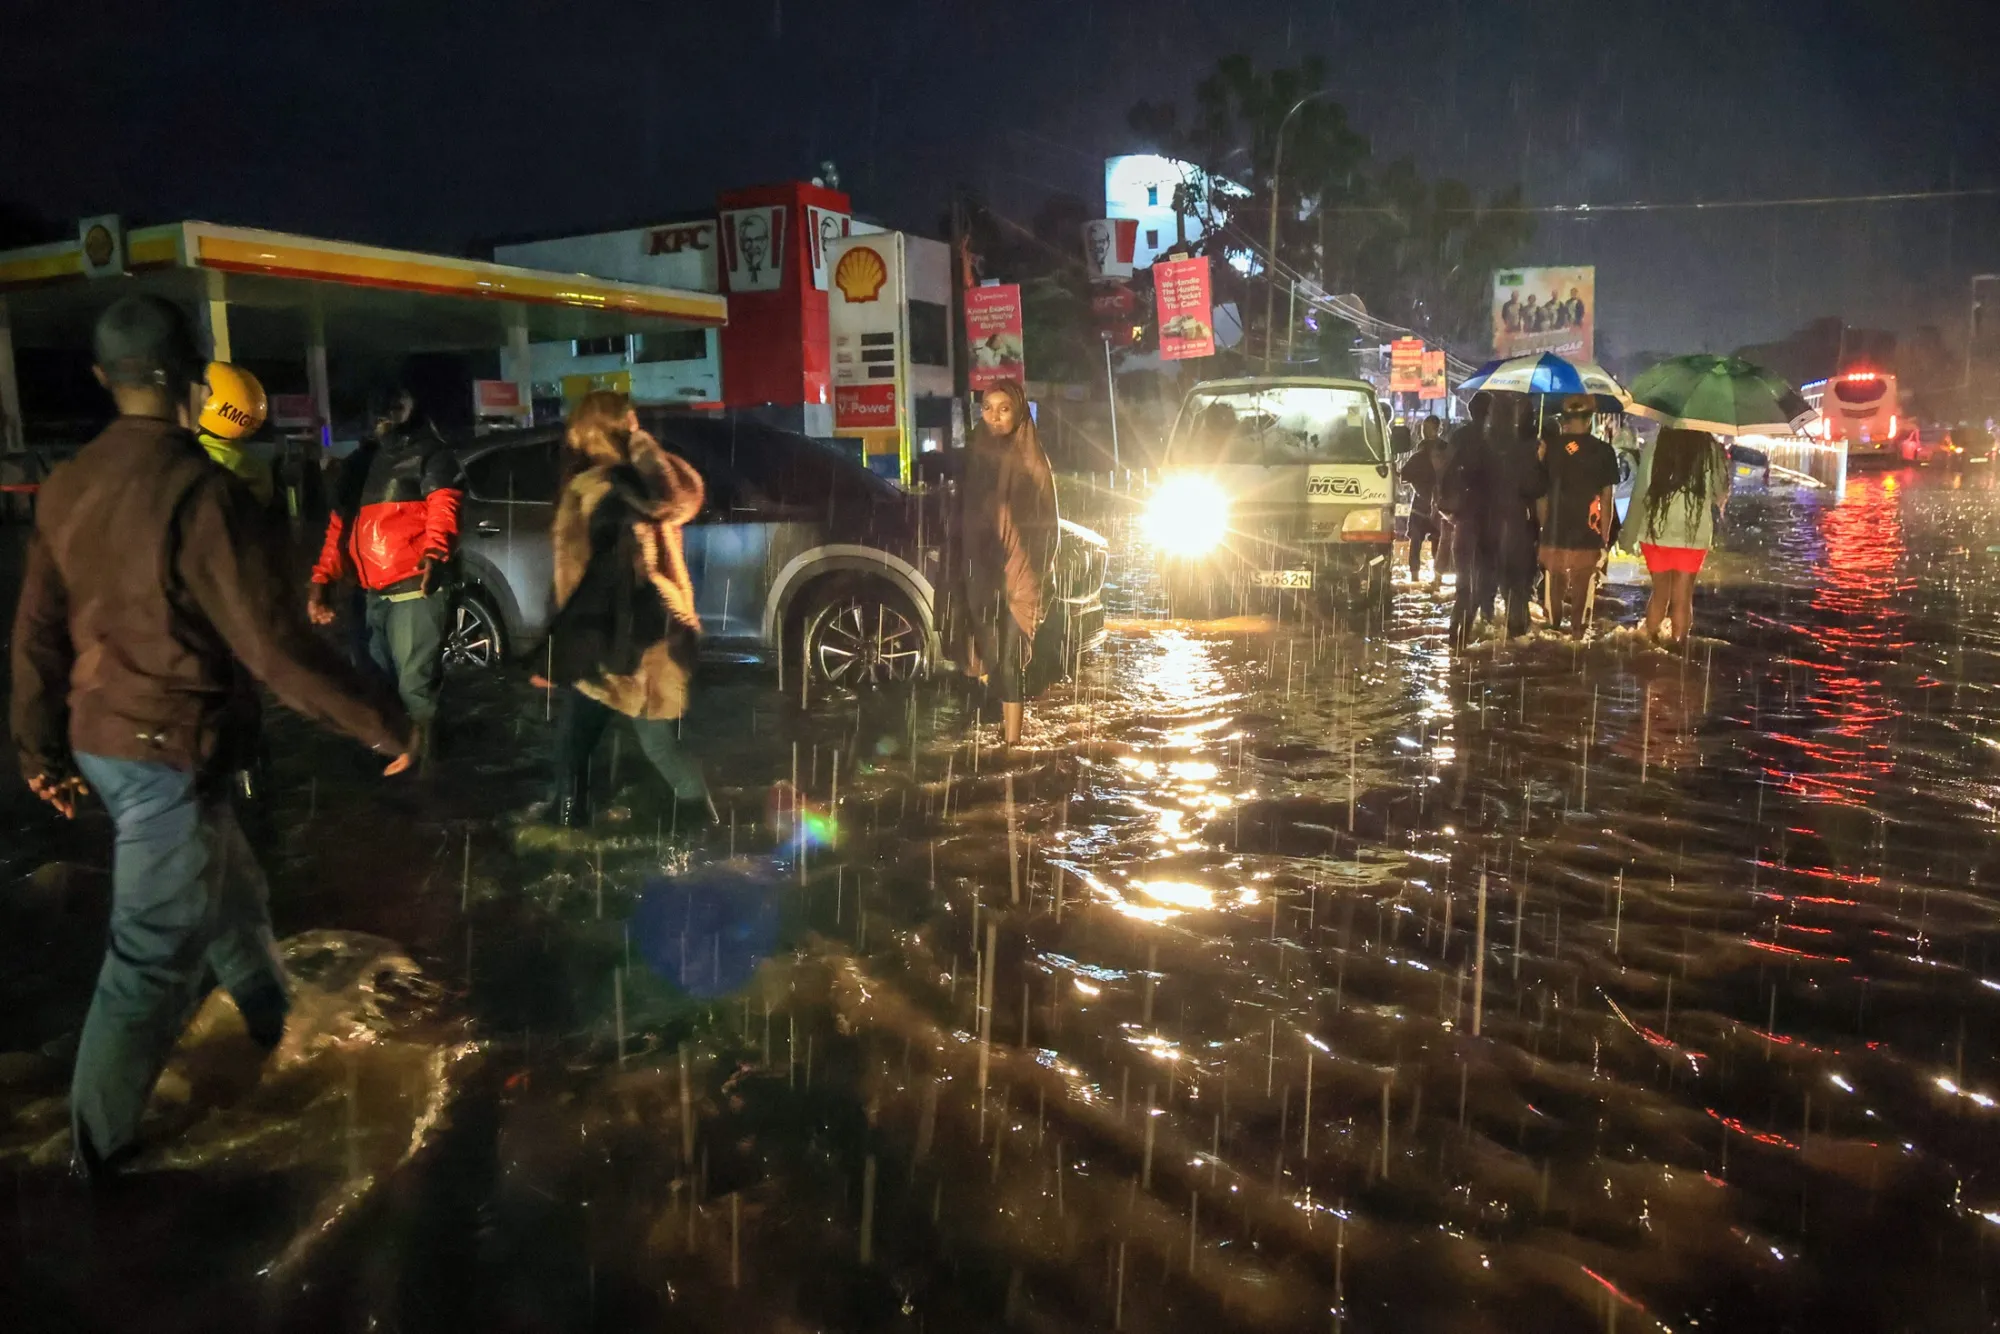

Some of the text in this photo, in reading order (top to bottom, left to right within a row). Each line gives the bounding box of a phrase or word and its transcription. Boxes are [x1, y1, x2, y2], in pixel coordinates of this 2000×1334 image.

[651, 226, 709, 255] KFC
[989, 304, 1015, 314] Exactly
[1490, 378, 1520, 386] Britam
[838, 401, 892, 414] V-Power
[1308, 477, 1361, 496] MCA
